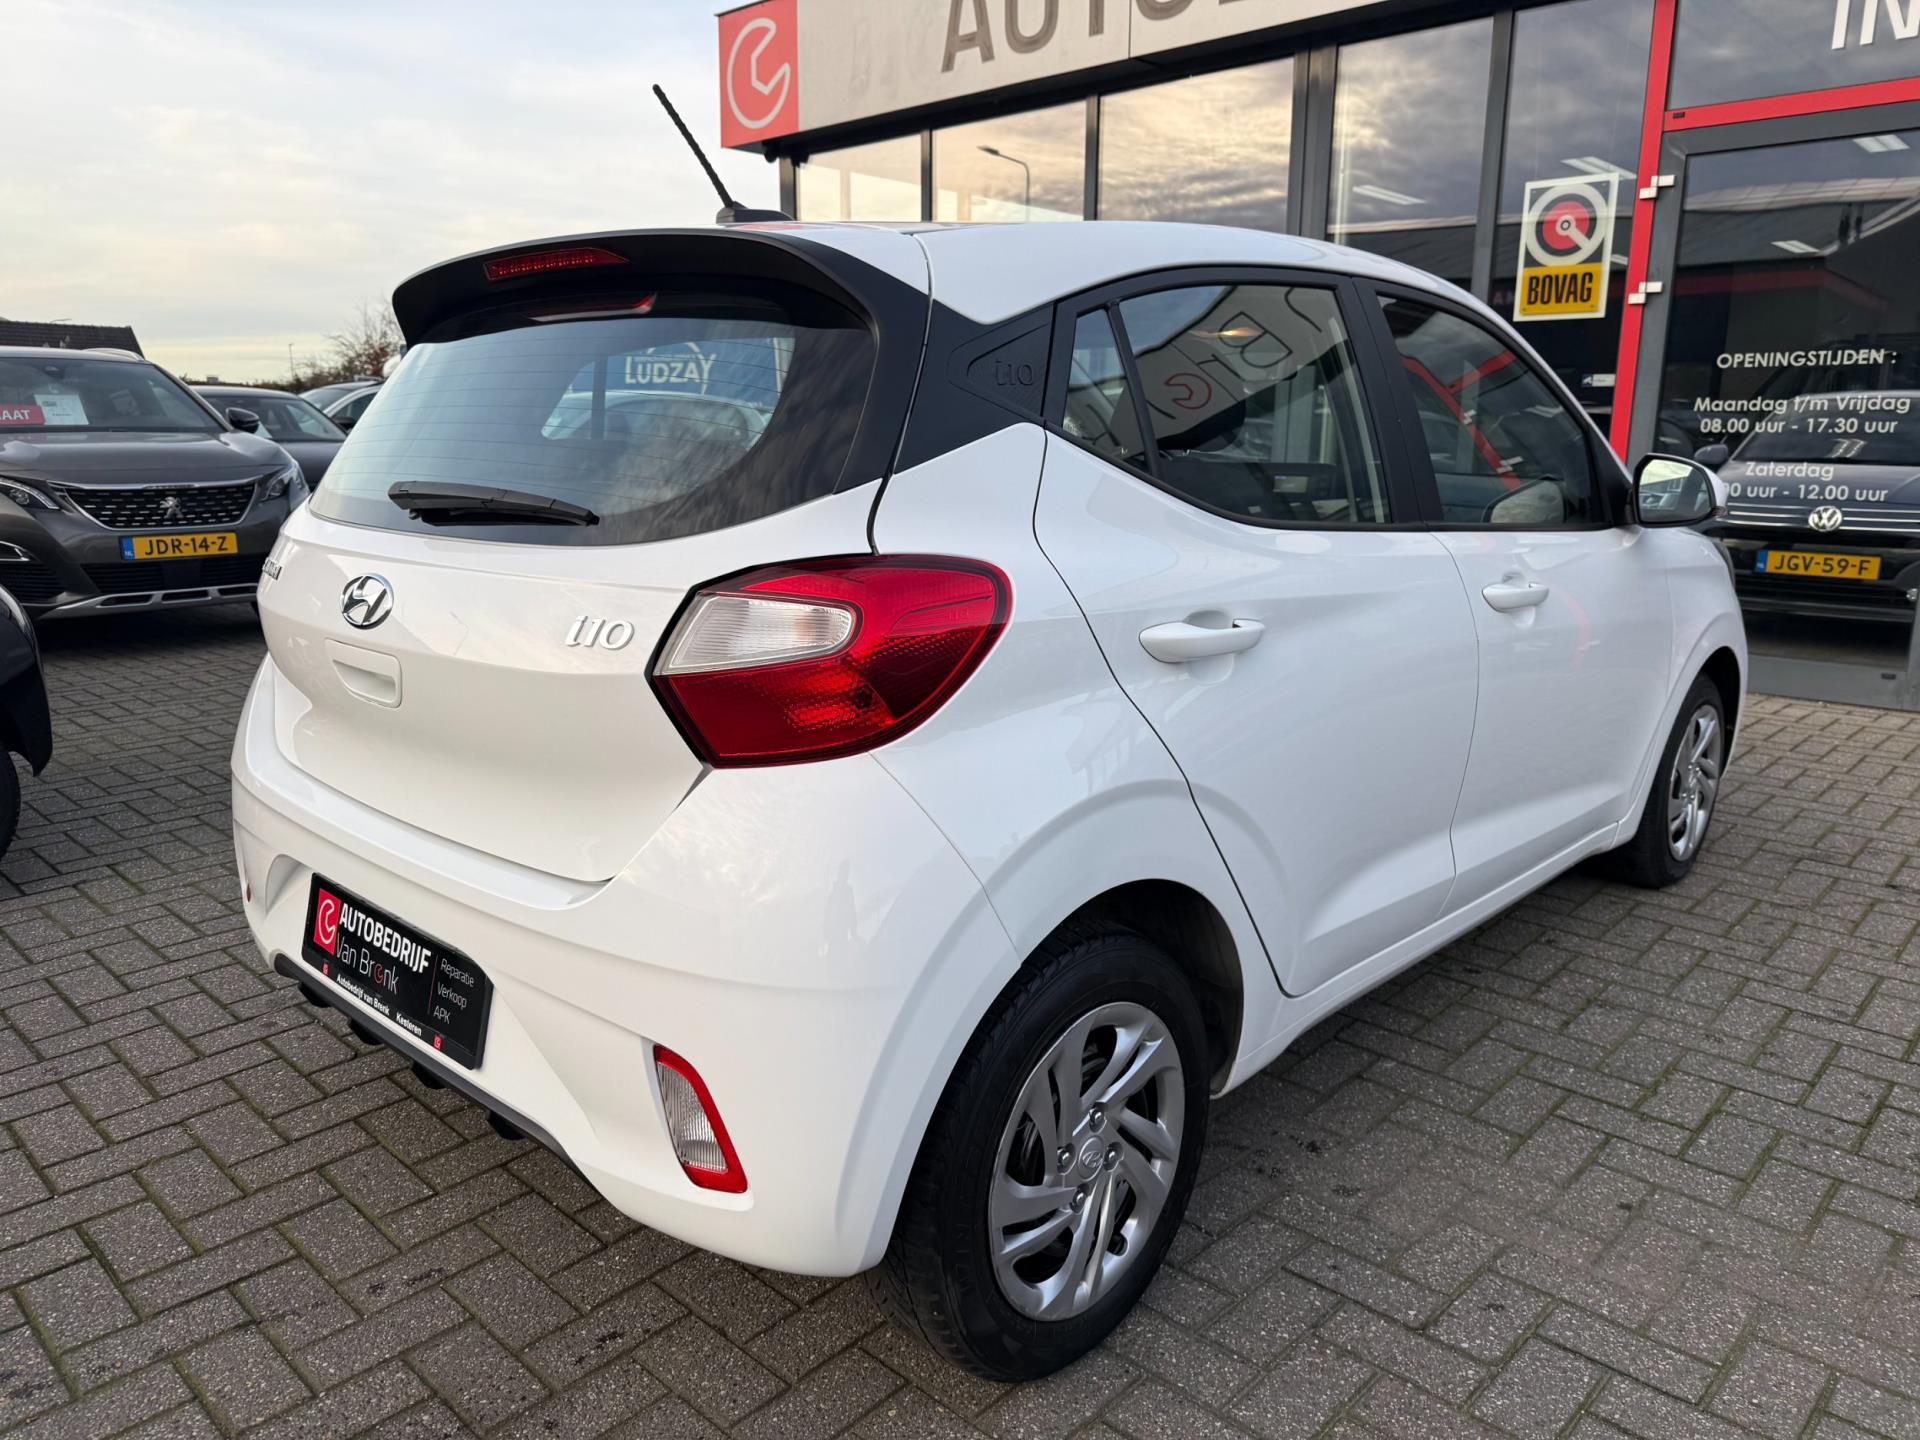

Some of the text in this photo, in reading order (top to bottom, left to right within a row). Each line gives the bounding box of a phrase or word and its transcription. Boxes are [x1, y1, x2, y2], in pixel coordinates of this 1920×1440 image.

[1526, 272, 1593, 305] BOVAG
[1716, 349, 1885, 368] OPENINGSTIJDEN
[625, 353, 717, 392] LUDZAY
[0, 409, 30, 420] AAT
[1693, 395, 1911, 414] Maandag t/m Vrijdag
[1700, 418, 1749, 433] 08.00
[1754, 420, 1786, 434] uur
[1806, 418, 1858, 433] 17.30
[1864, 420, 1898, 433] uur
[1745, 462, 1834, 481] Zaterdag
[1746, 486, 1777, 498] uur
[1798, 484, 1849, 500] 12.00
[1855, 488, 1888, 501] uur
[145, 536, 229, 556] JDR-14-Z
[1774, 556, 1871, 576] JGV-59-F
[565, 615, 635, 651] i10
[339, 902, 432, 973] AUTOBEDRIJF
[336, 932, 357, 968] Van
[441, 958, 475, 988] Reparatie
[336, 974, 363, 999] Autobedrijf
[396, 1012, 422, 1037] Kesteren
[437, 981, 467, 1010] Verkoop
[433, 1005, 451, 1025] APK
